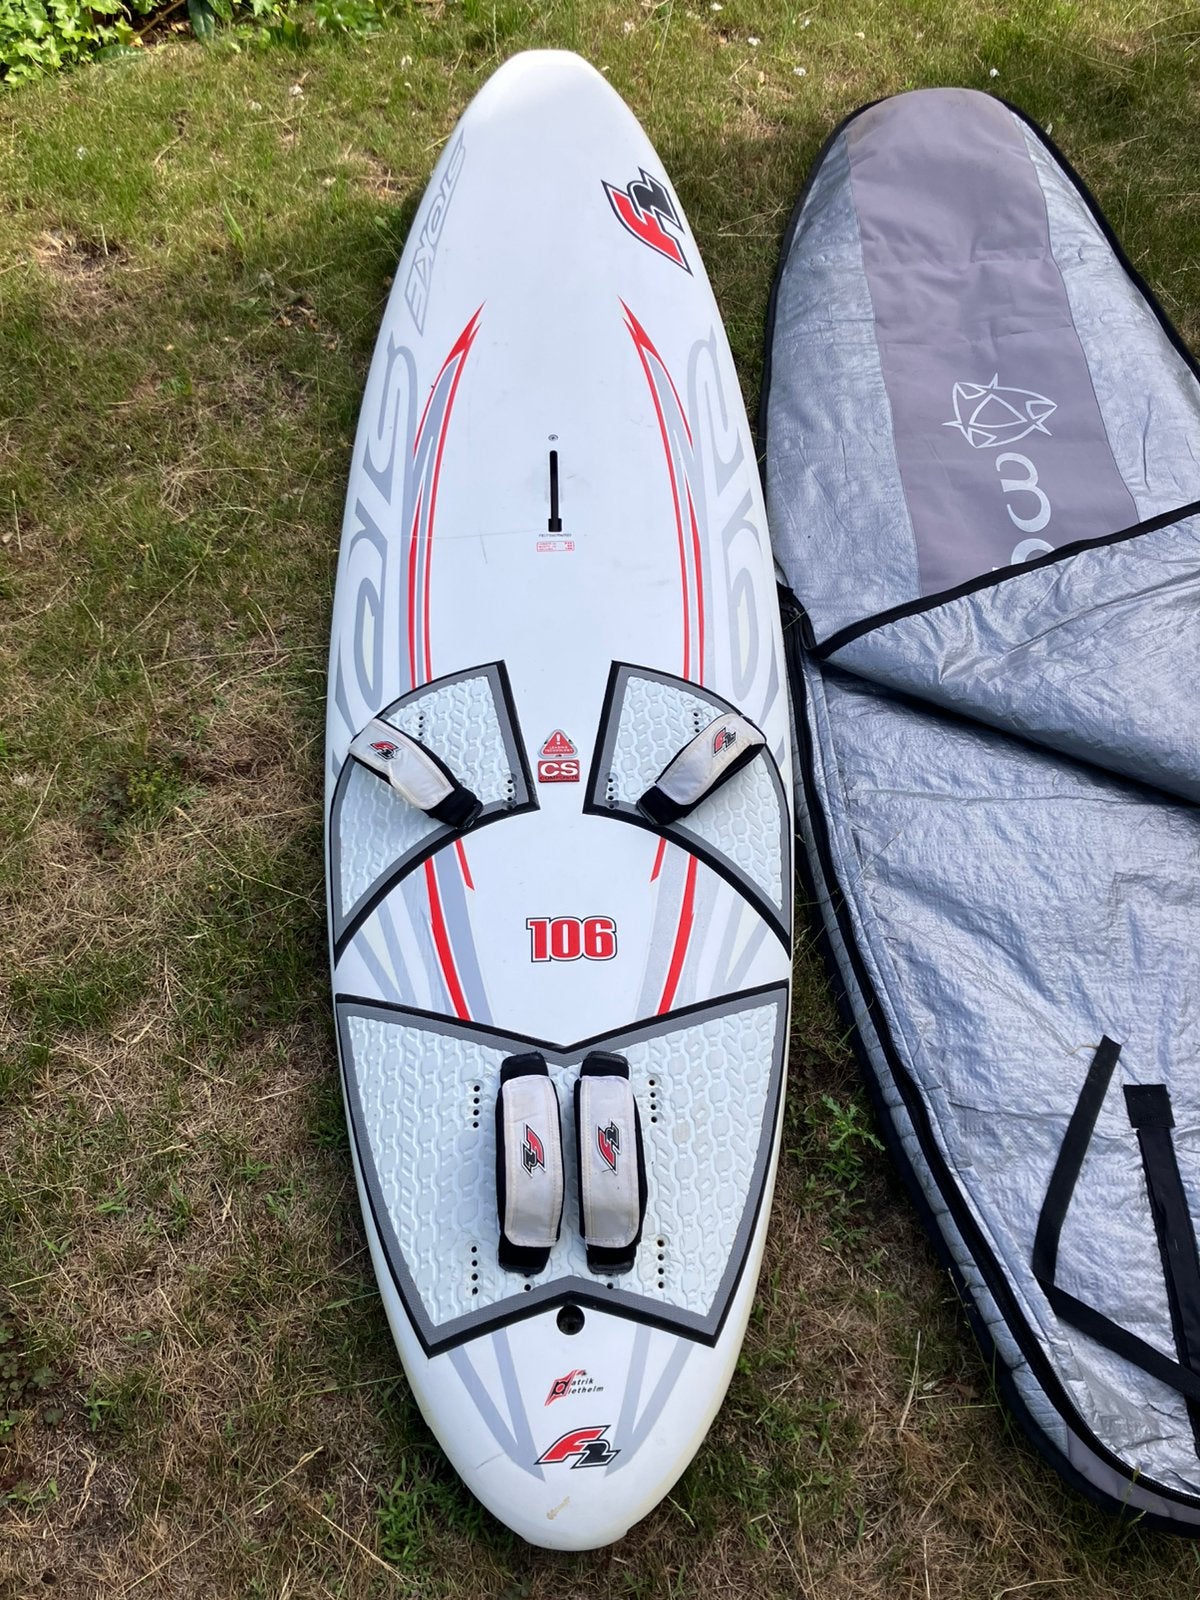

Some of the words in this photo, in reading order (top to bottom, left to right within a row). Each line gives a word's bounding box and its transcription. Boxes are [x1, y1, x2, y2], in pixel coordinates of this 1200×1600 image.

[600, 166, 694, 278] F2
[540, 761, 579, 777] CS
[526, 915, 618, 962] 106
[533, 1424, 622, 1470] F2
